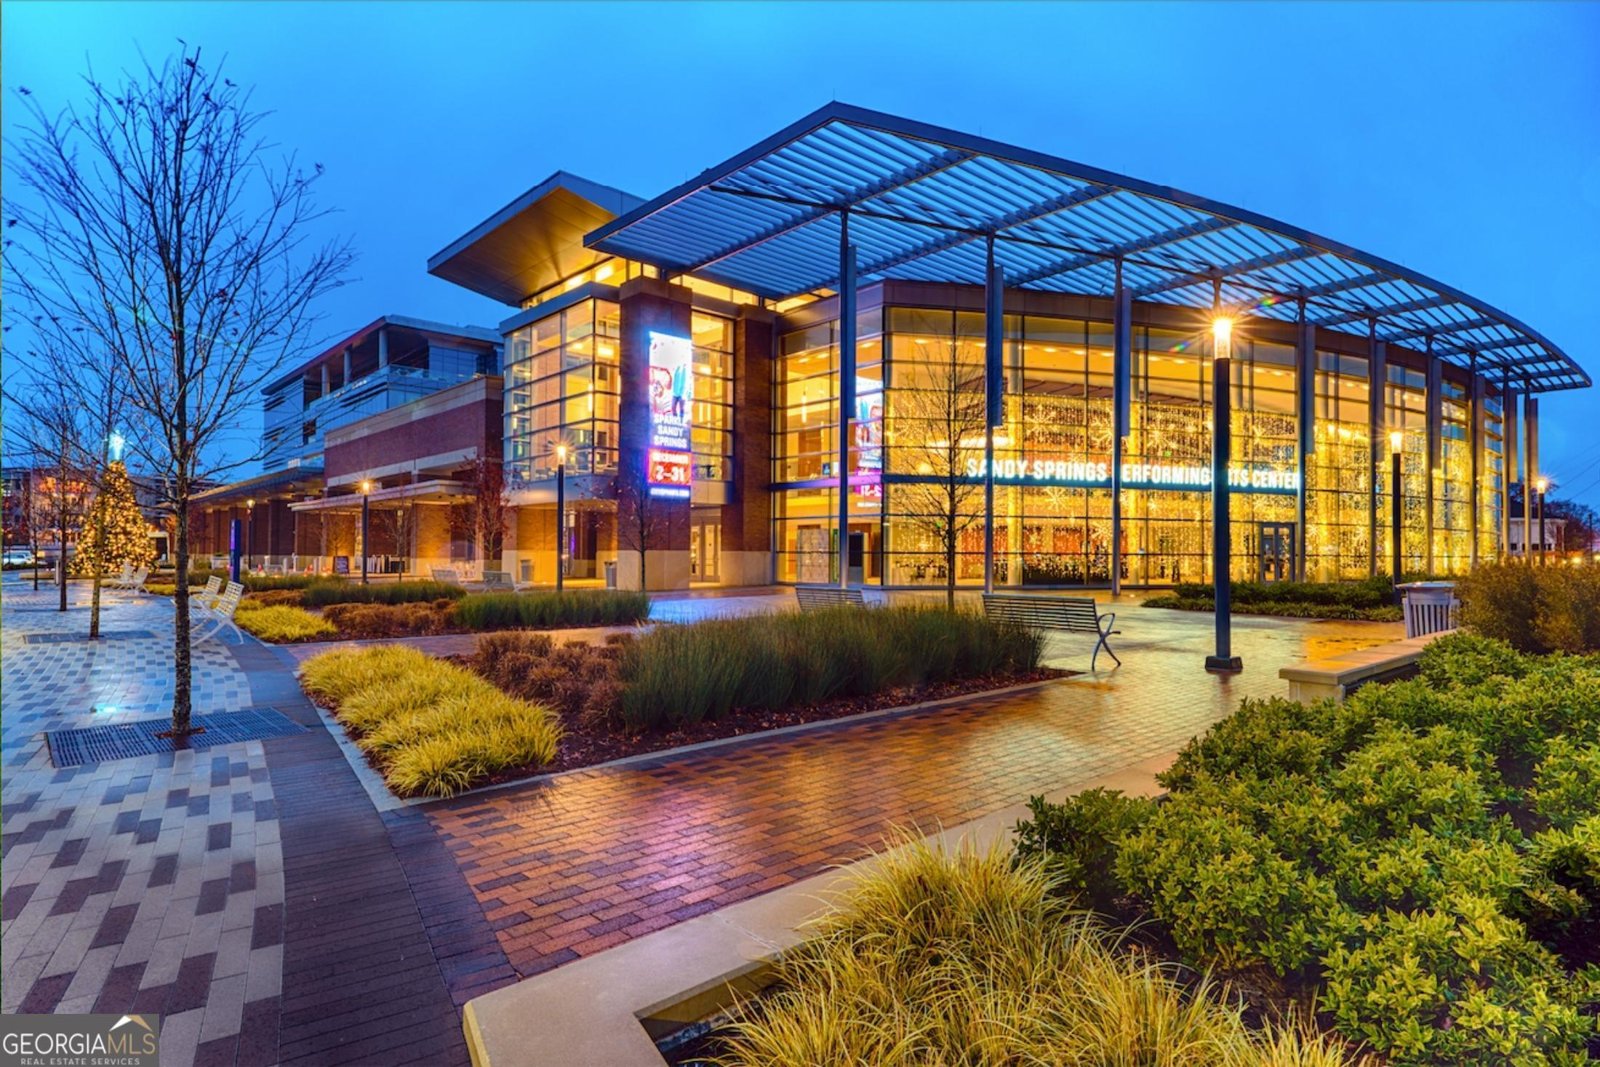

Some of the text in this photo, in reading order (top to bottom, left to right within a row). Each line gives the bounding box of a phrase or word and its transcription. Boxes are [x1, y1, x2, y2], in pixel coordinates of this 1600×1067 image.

[657, 424, 683, 437] SANDY
[653, 435, 688, 449] SPRINGS
[656, 465, 684, 482] 2-31
[967, 458, 1027, 478] SANDY
[1033, 461, 1107, 482] SPRINGS
[1121, 464, 1211, 486] ERFORMING
